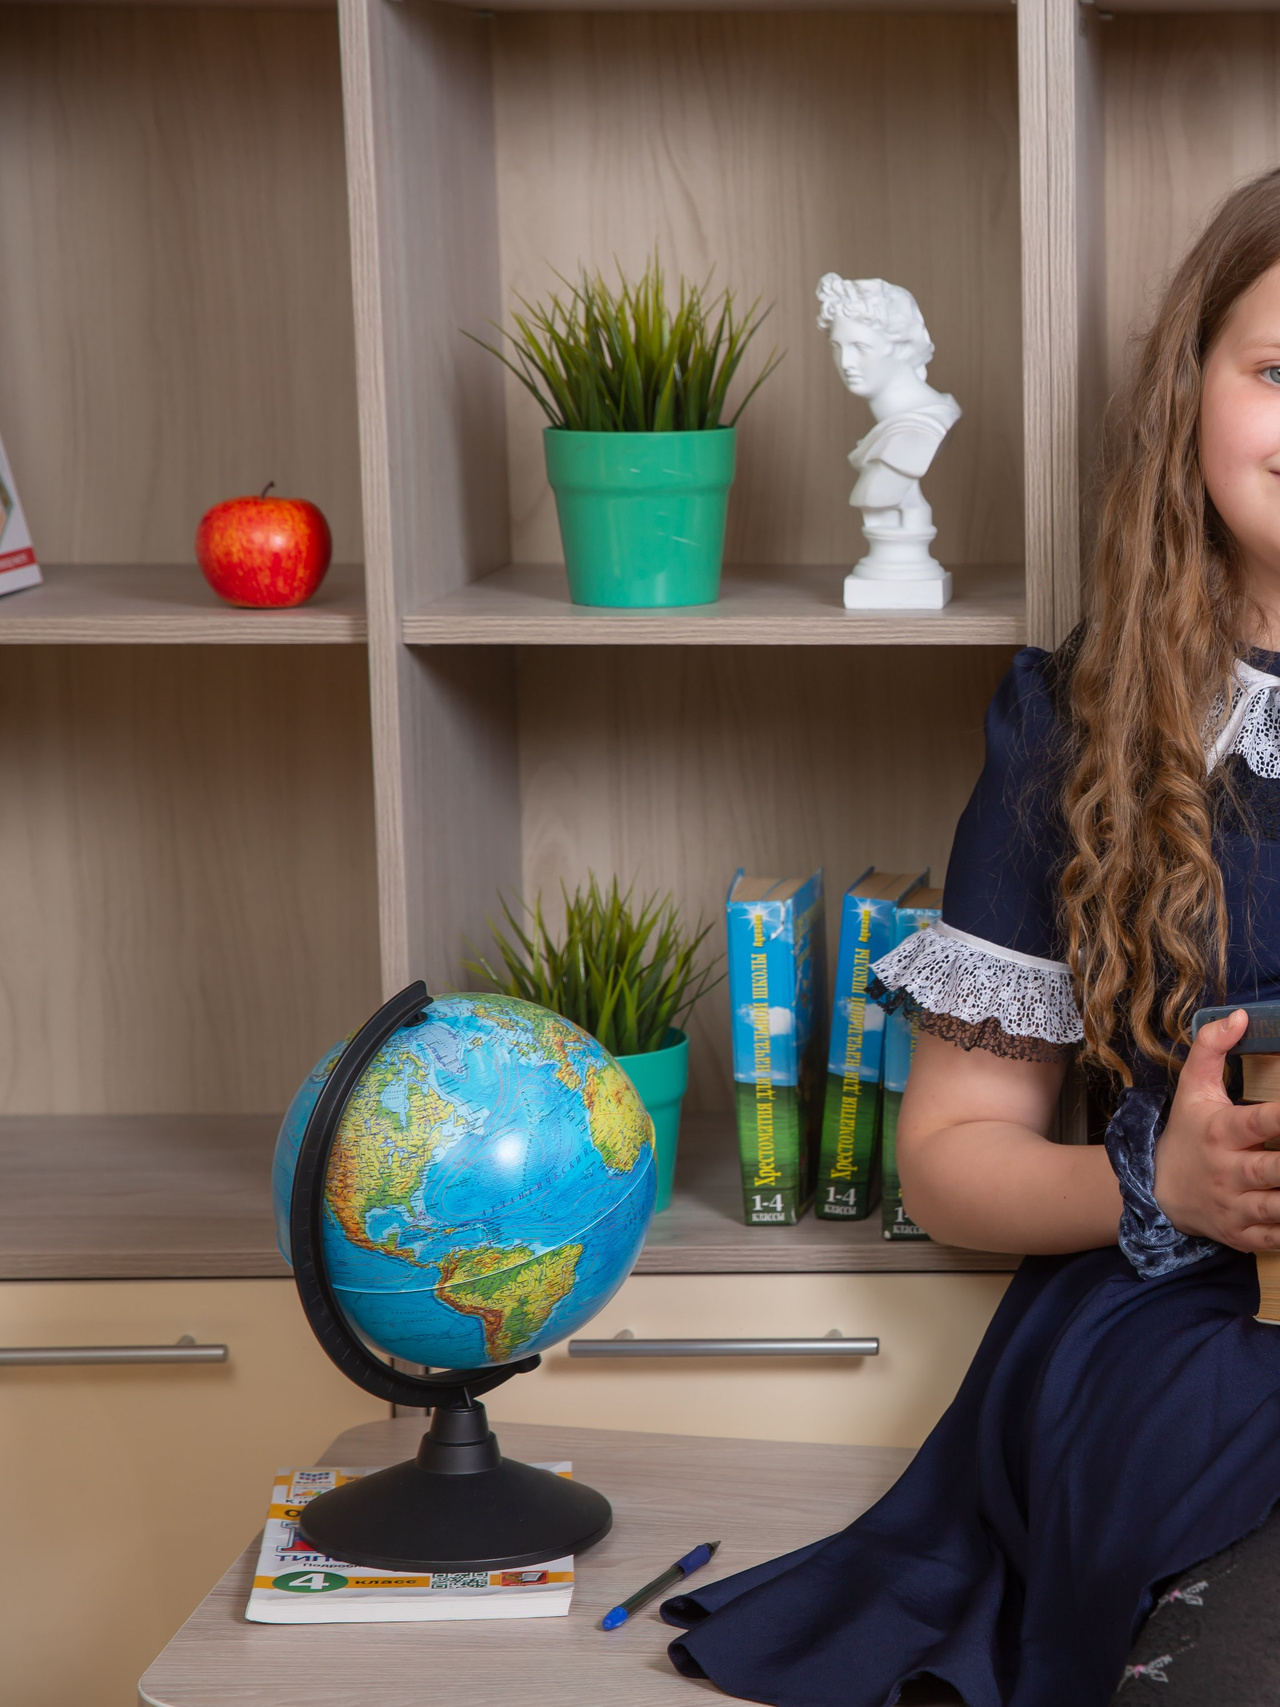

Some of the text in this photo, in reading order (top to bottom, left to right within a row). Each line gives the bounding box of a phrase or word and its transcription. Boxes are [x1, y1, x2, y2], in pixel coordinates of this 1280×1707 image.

[751, 953, 769, 999] школы
[748, 1002, 771, 1072] начальной
[845, 996, 867, 1067] начальной
[756, 1077, 777, 1100] для
[843, 1070, 863, 1095] для
[754, 1102, 781, 1187] Хрестоматия
[830, 1095, 858, 1180] Хрестоматия
[752, 1194, 784, 1212] 1-4
[826, 1187, 857, 1206] 1-4
[752, 1212, 785, 1221] классы
[824, 1204, 857, 1215] классы
[894, 1207, 908, 1222] 1-
[288, 1573, 330, 1590] 4
